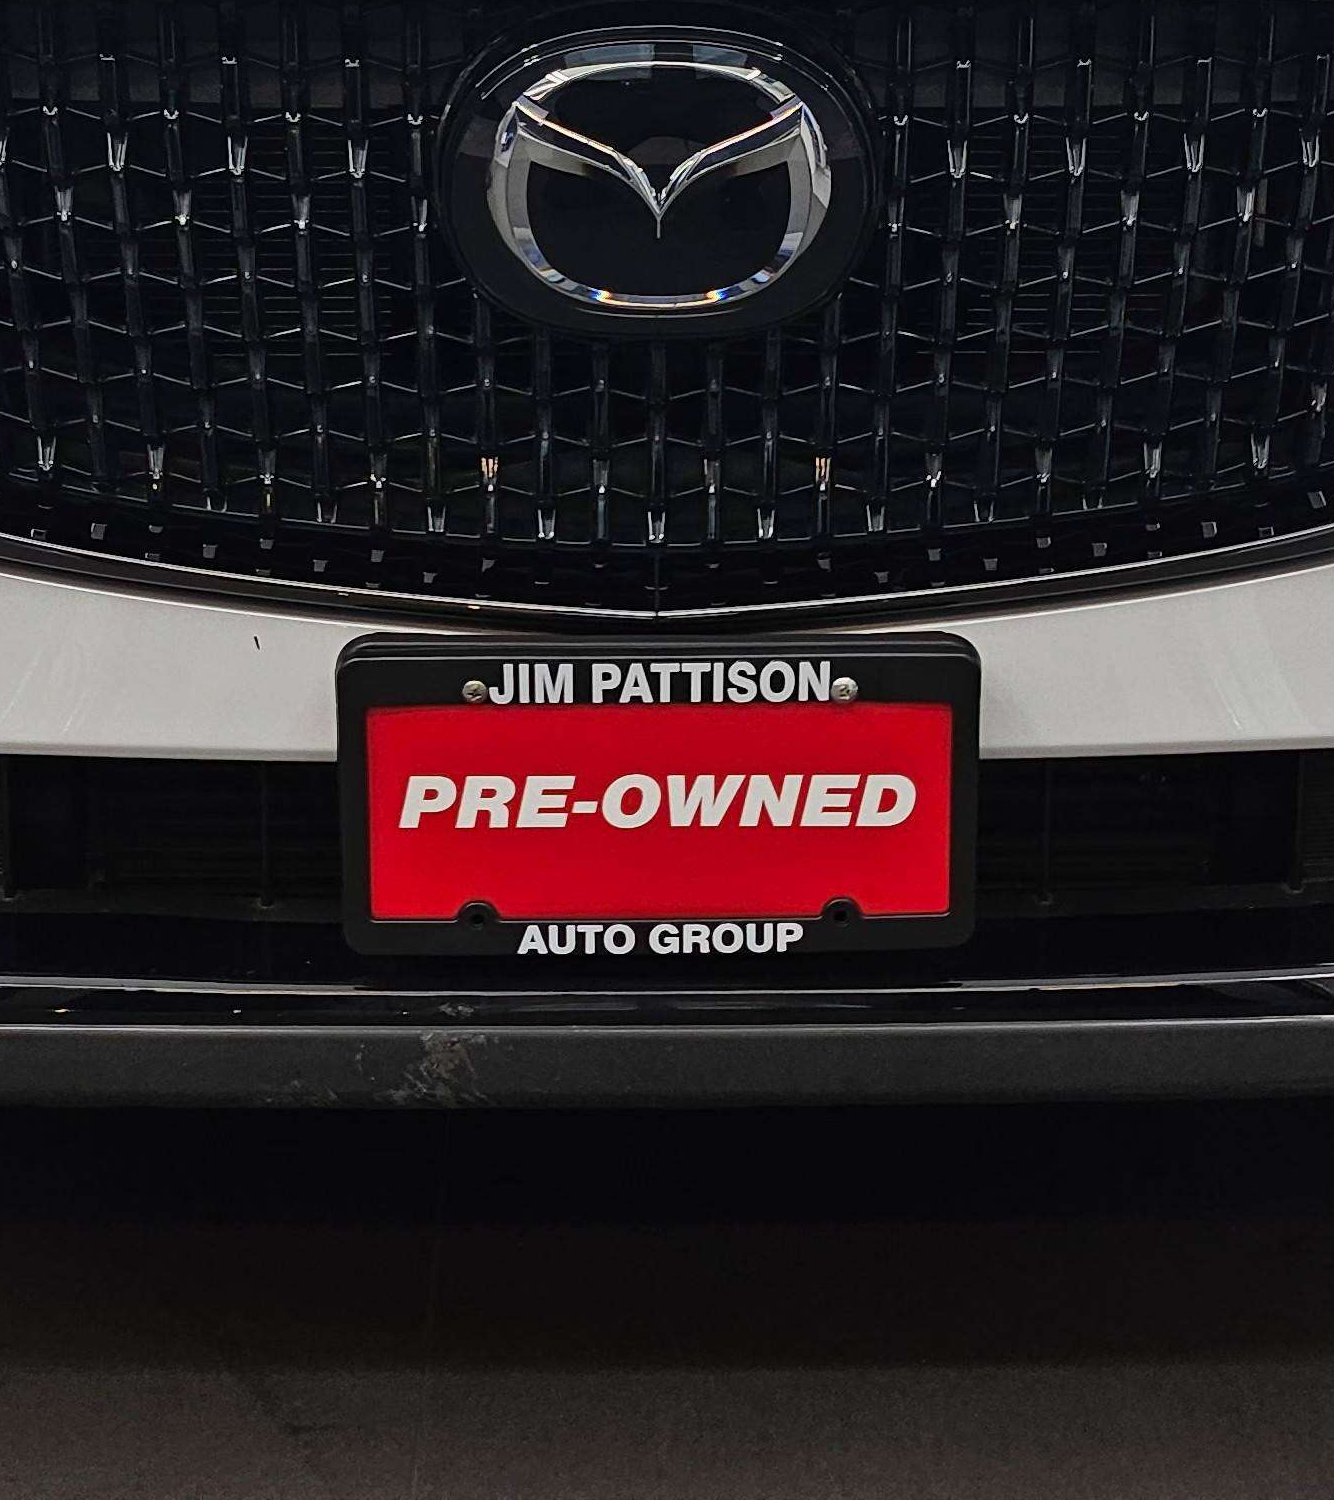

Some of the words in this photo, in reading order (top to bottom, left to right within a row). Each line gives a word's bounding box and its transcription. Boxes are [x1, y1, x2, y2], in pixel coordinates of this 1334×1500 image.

[488, 663, 574, 704] JIM
[591, 661, 831, 704] PATTISON
[398, 773, 917, 829] PRE-OWNED
[517, 924, 636, 955] AUTO
[648, 922, 804, 955] GROUP
